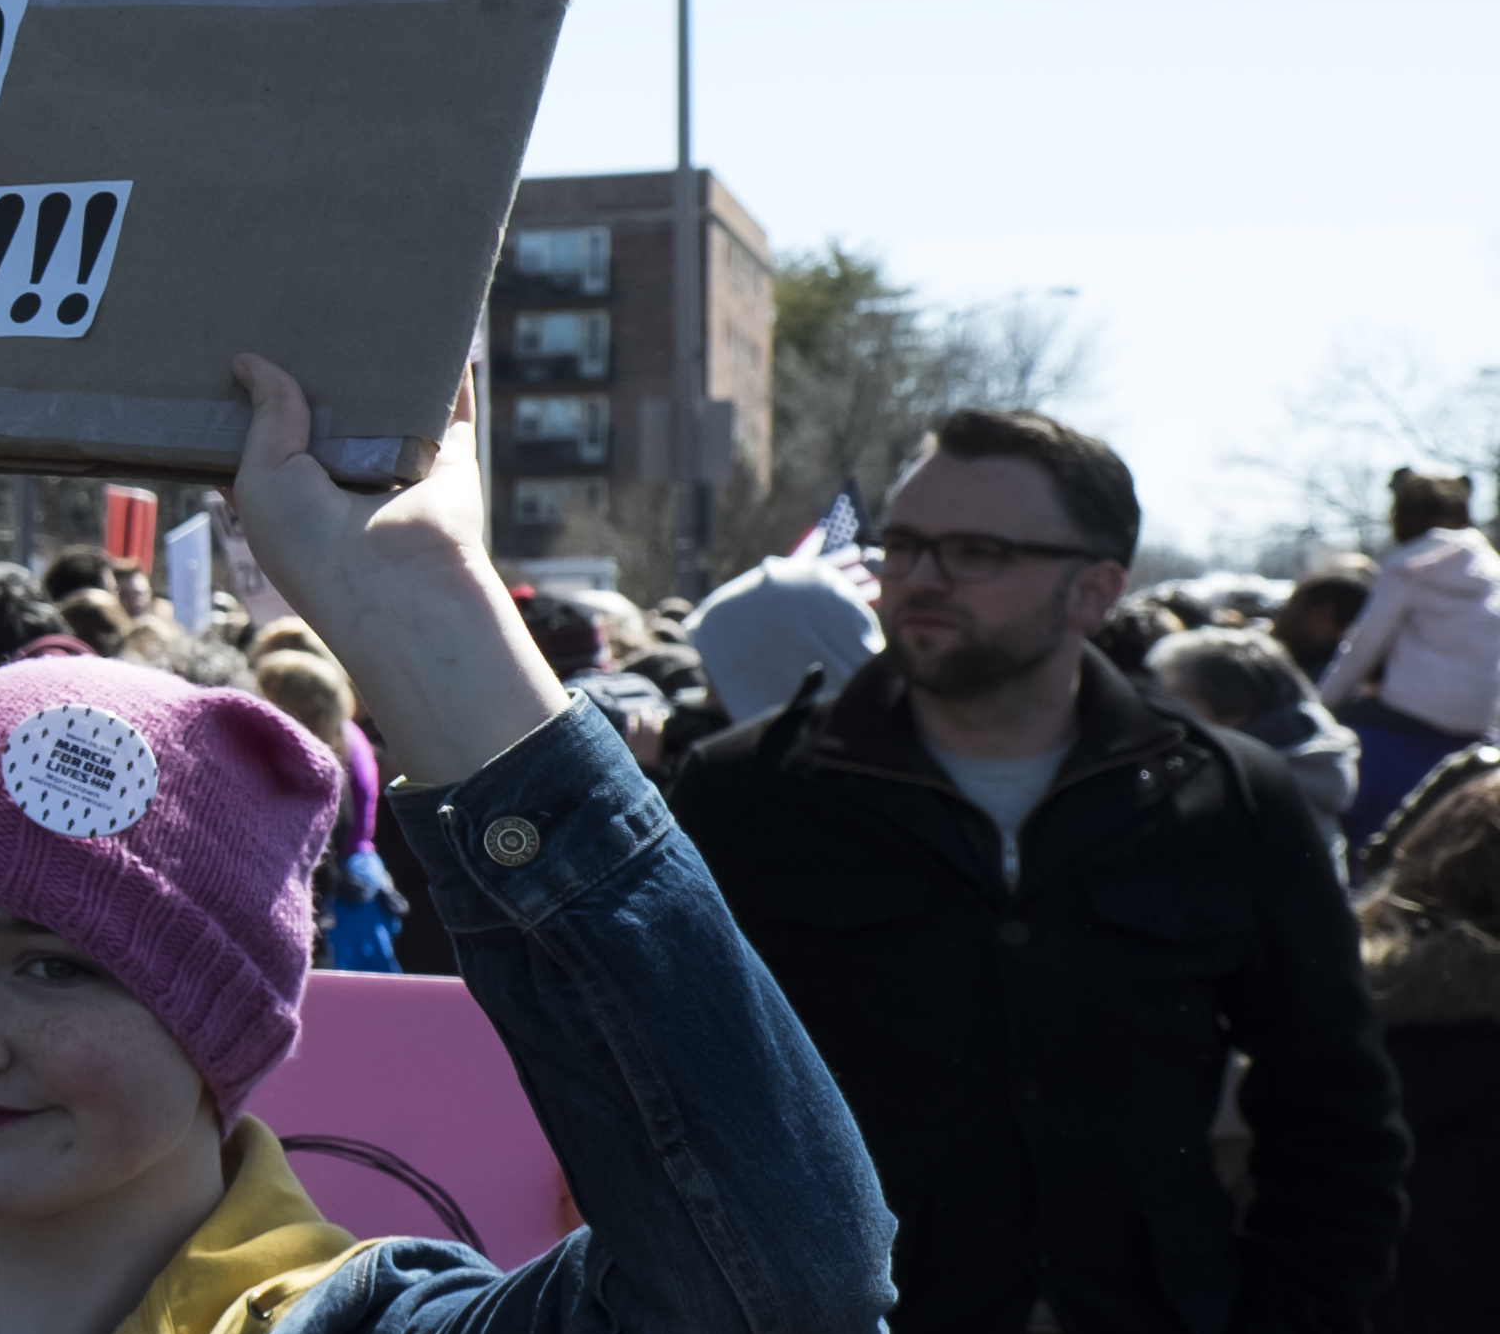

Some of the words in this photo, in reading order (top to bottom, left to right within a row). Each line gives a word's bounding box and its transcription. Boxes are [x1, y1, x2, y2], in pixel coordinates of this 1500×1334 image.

[51, 749, 81, 769] FOR
[83, 761, 116, 781] OUR
[55, 739, 112, 767] MARCH
[46, 760, 89, 784] LIVES
